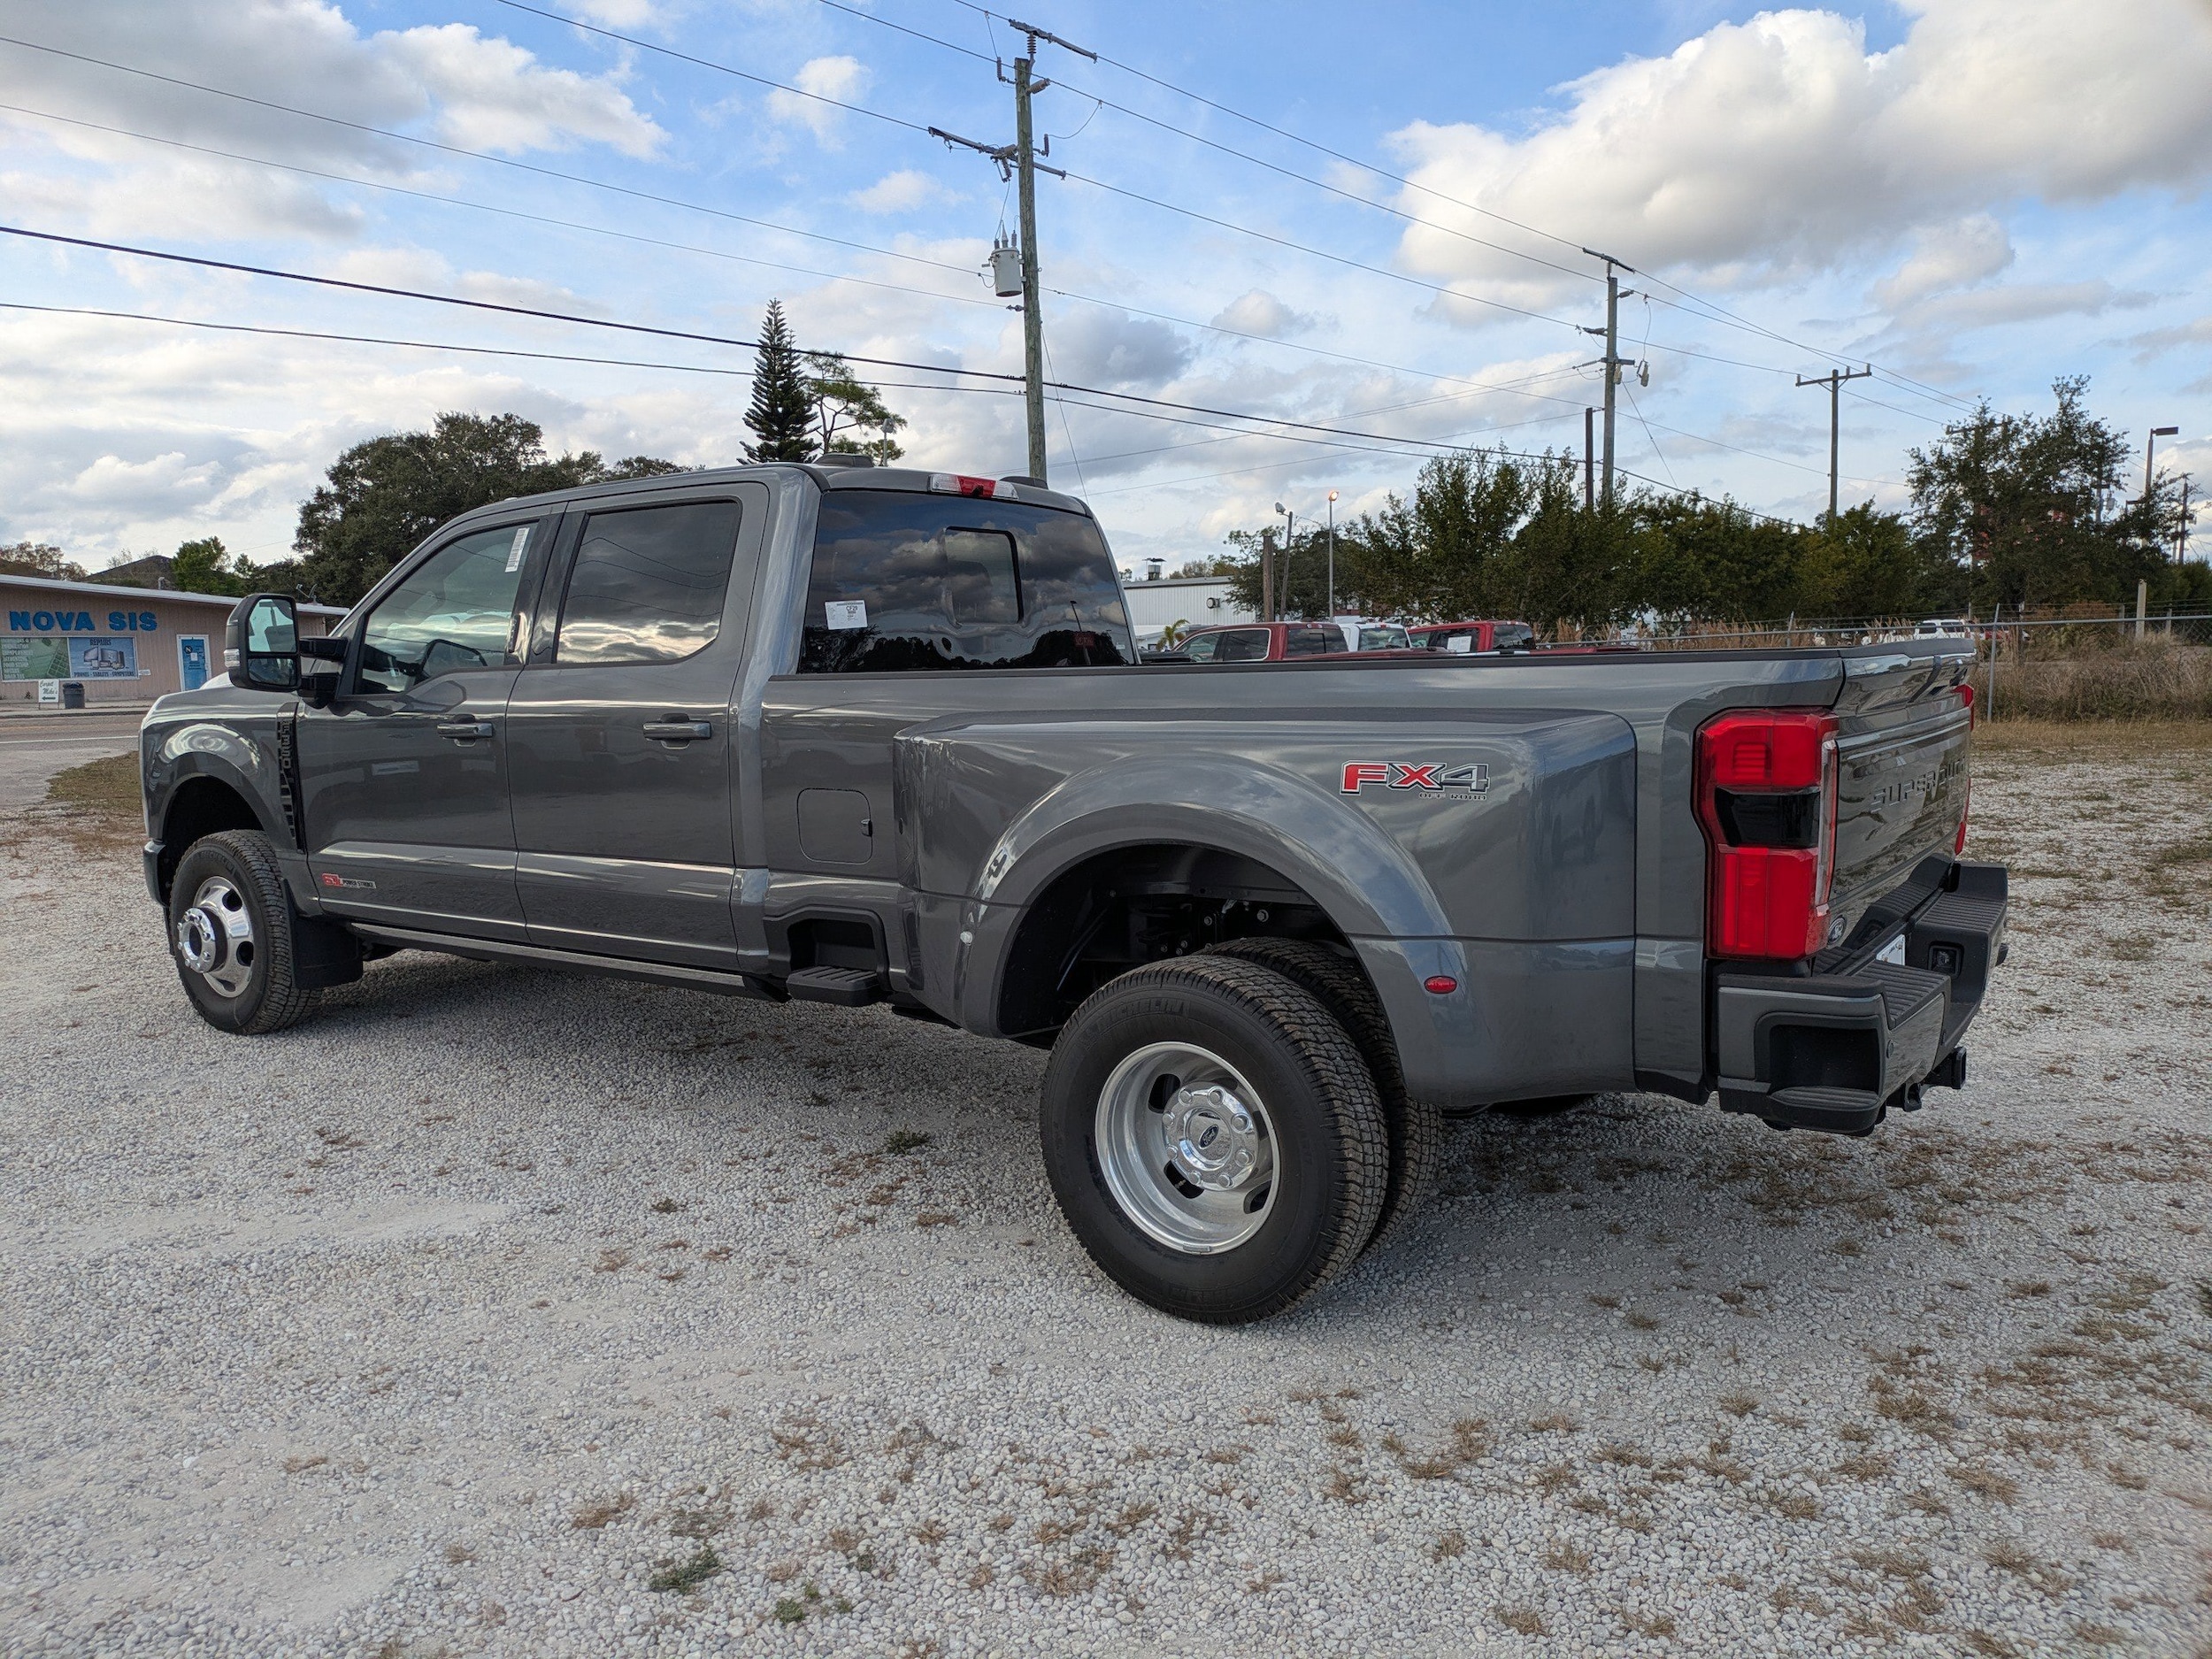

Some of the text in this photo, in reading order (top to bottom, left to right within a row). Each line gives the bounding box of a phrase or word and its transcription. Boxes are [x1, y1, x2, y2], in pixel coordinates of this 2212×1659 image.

[10, 611, 157, 631] NOVA SIS
[1340, 760, 1491, 795] FX4
[1870, 771, 1935, 813] SUPER
